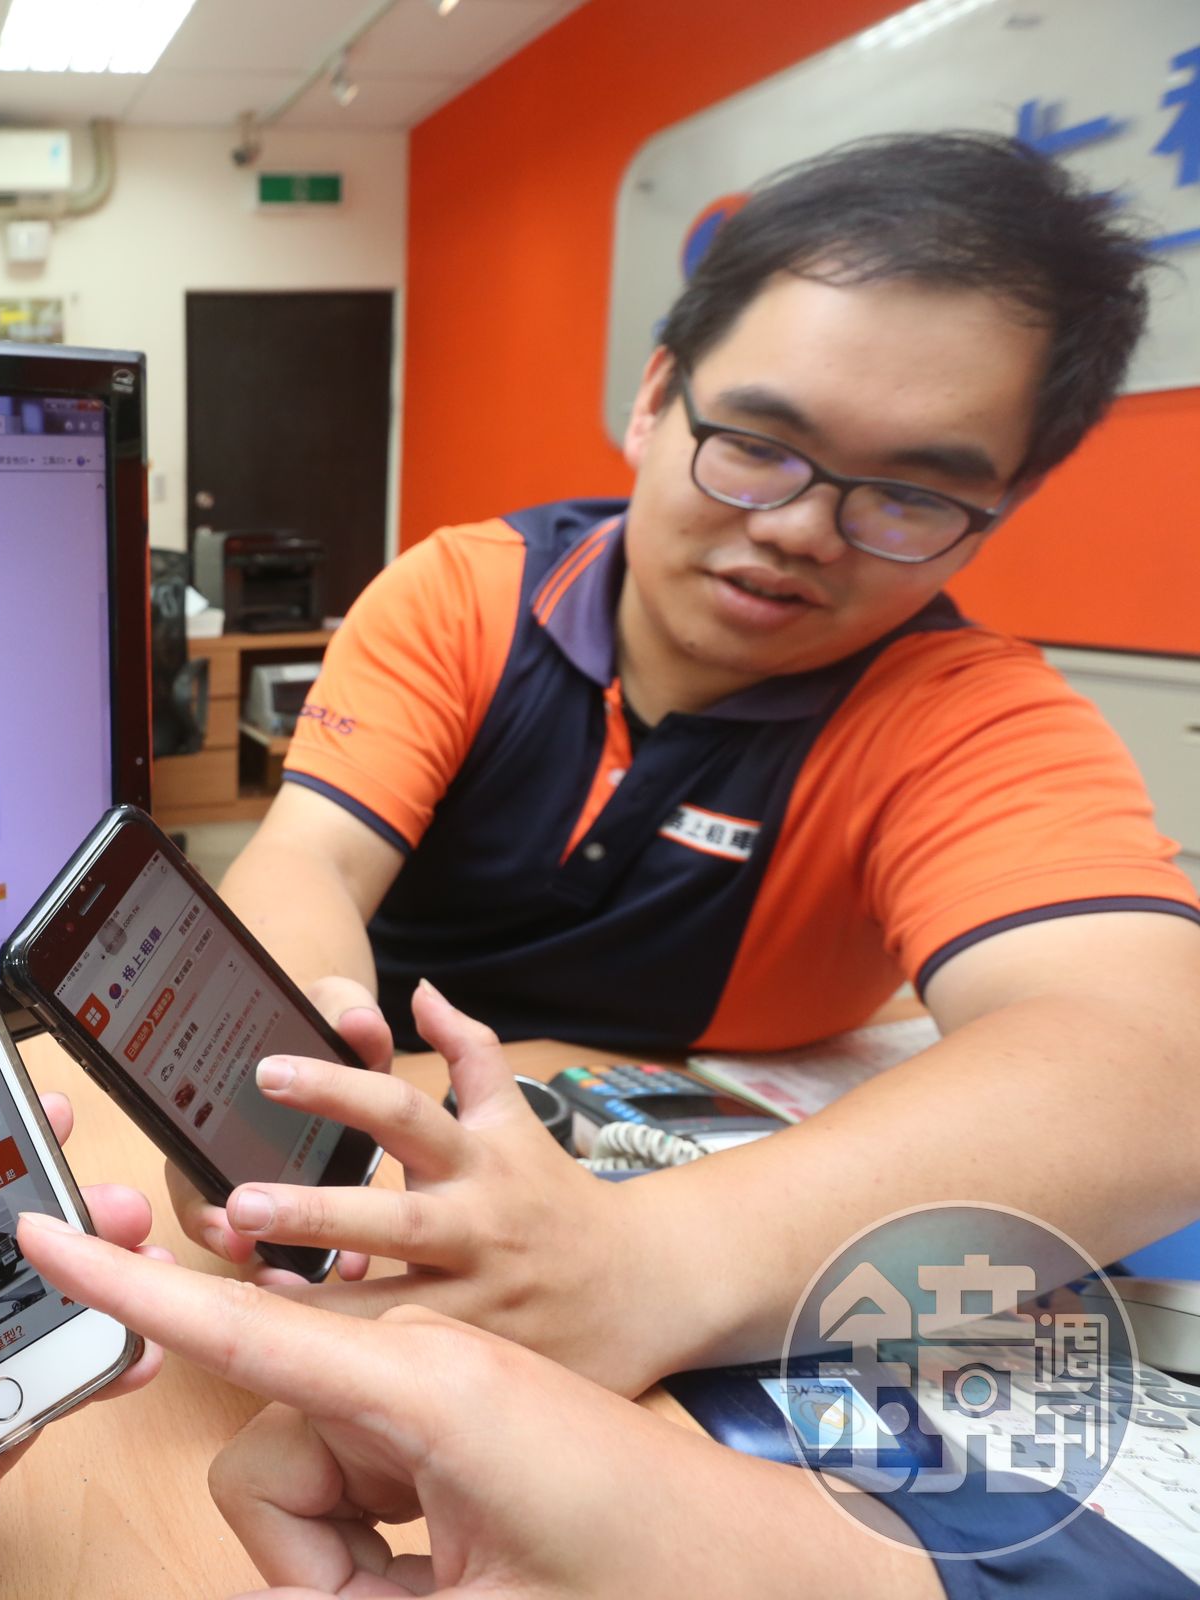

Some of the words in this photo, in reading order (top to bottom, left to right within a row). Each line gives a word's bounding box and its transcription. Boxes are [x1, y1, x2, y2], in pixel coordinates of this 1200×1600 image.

[121, 924, 163, 983] 格上租車
[173, 1021, 198, 1060] 全部車種
[4, 1168, 17, 1181] 起
